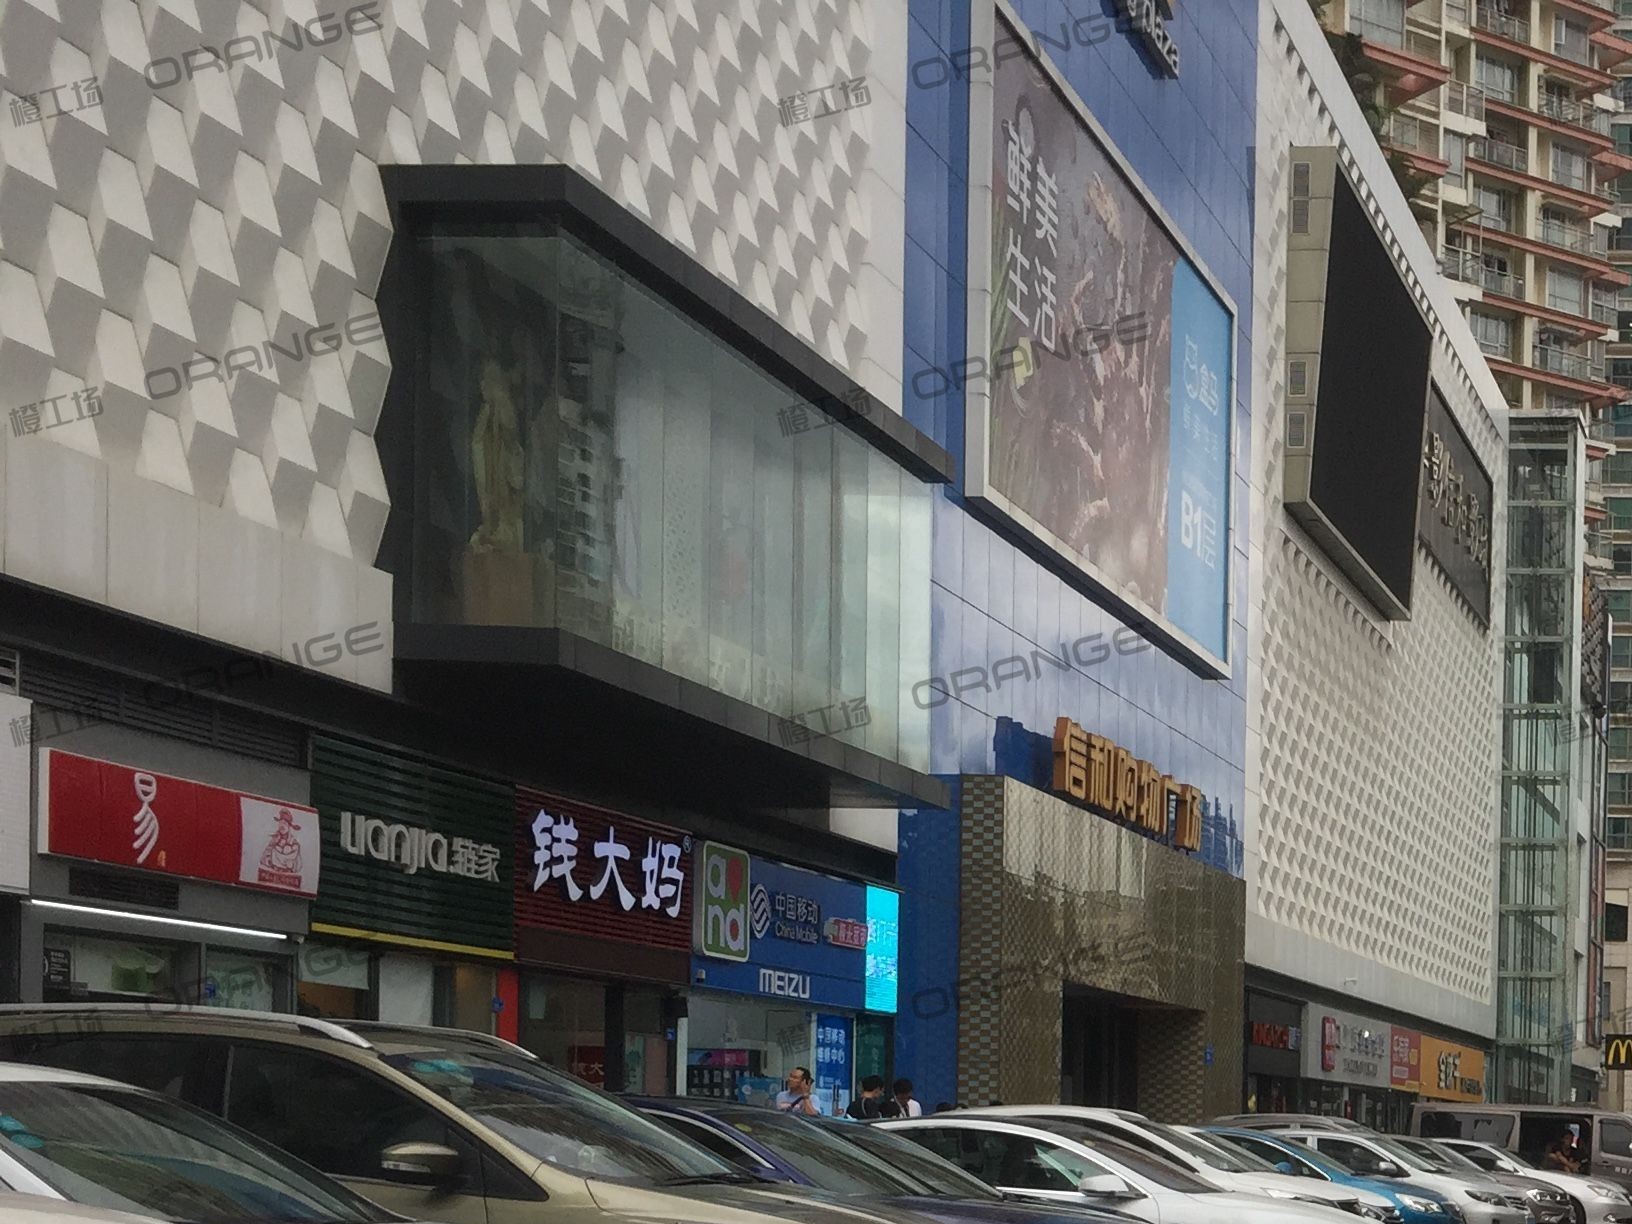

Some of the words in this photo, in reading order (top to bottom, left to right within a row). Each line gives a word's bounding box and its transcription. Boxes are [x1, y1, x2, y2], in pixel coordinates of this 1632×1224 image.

[1006, 227, 1058, 352] 生活
[532, 808, 684, 918] 钱大妈
[775, 893, 819, 925] 中国移动
[759, 967, 810, 999] MEIZU
